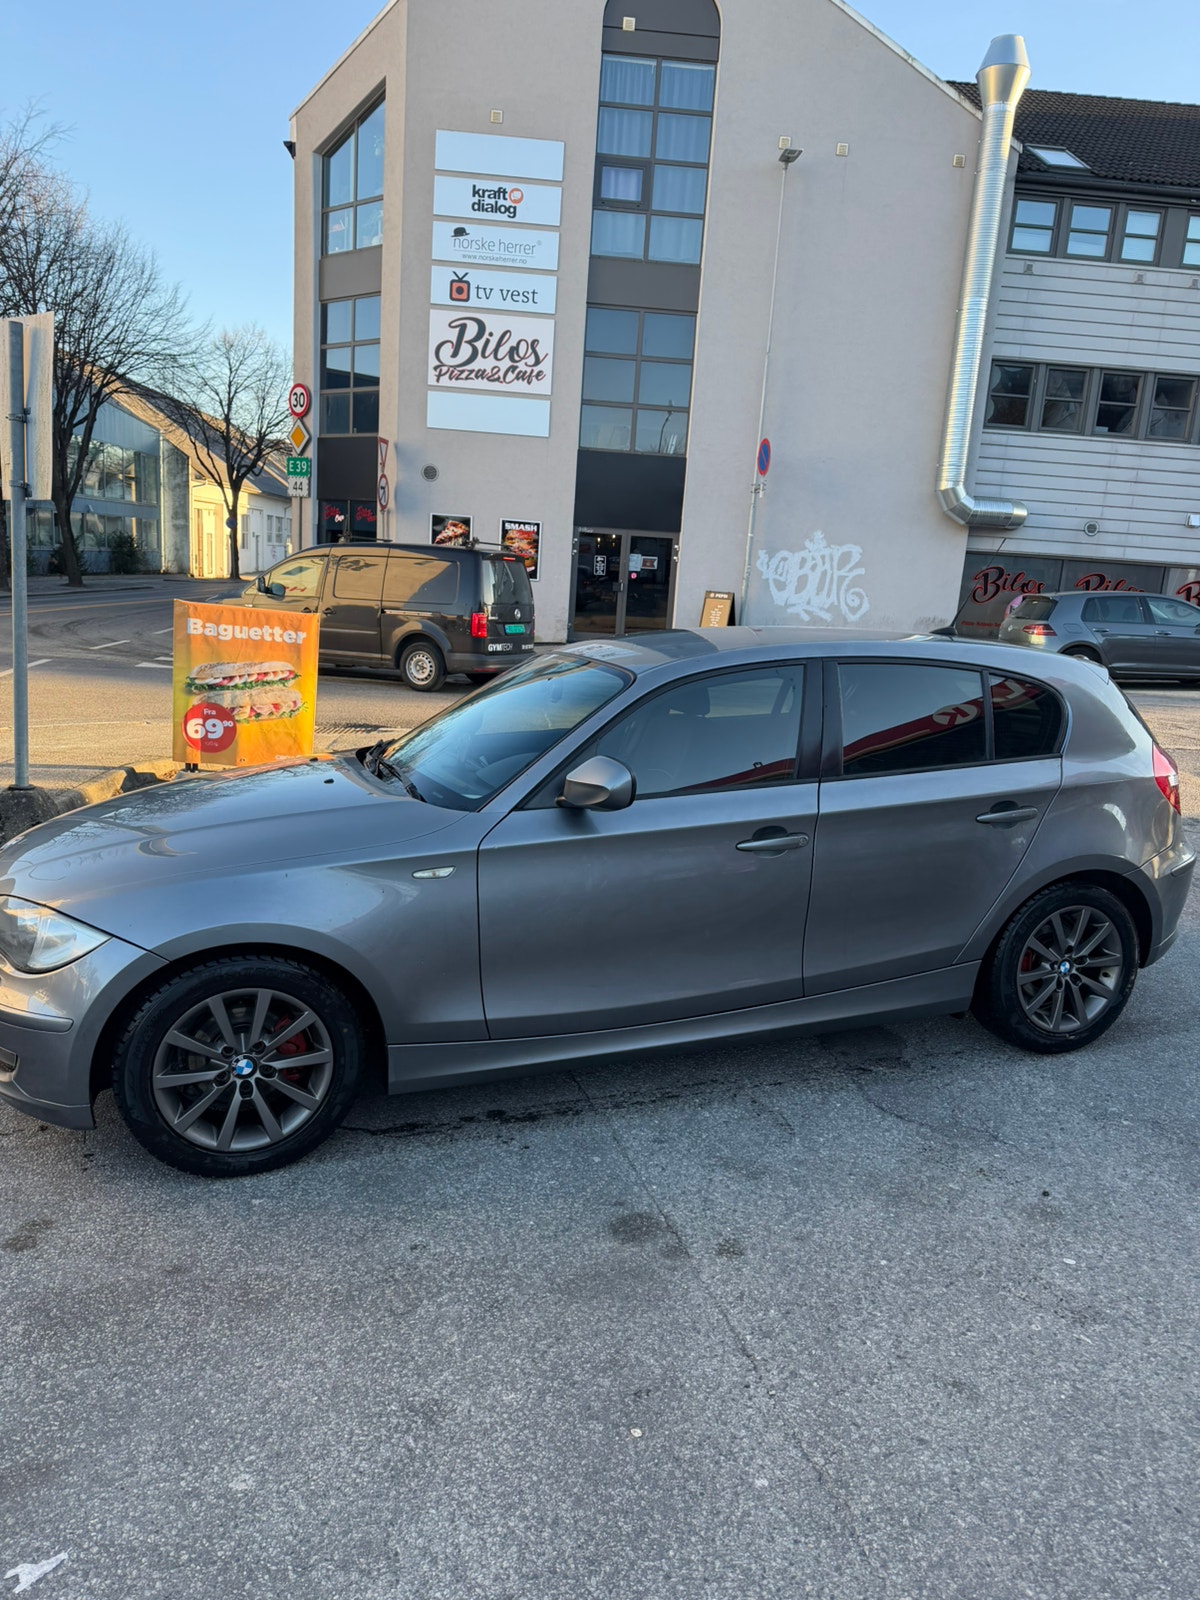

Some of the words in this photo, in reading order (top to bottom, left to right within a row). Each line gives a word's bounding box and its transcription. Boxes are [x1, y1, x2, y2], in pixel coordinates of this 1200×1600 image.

[472, 184, 508, 200] kraft
[471, 199, 517, 219] dialog
[453, 237, 496, 252] norske
[498, 239, 536, 255] herrer
[462, 253, 527, 264] www.norskeherrer.no
[475, 284, 494, 300] tv
[499, 288, 538, 304] vest
[434, 316, 549, 368] Bilos
[292, 392, 306, 408] 30
[289, 462, 295, 472] E
[295, 461, 307, 473] 39
[292, 481, 303, 491] 44
[505, 522, 538, 532] SMASH
[186, 617, 307, 644] Baguetter
[203, 708, 217, 716] Fra
